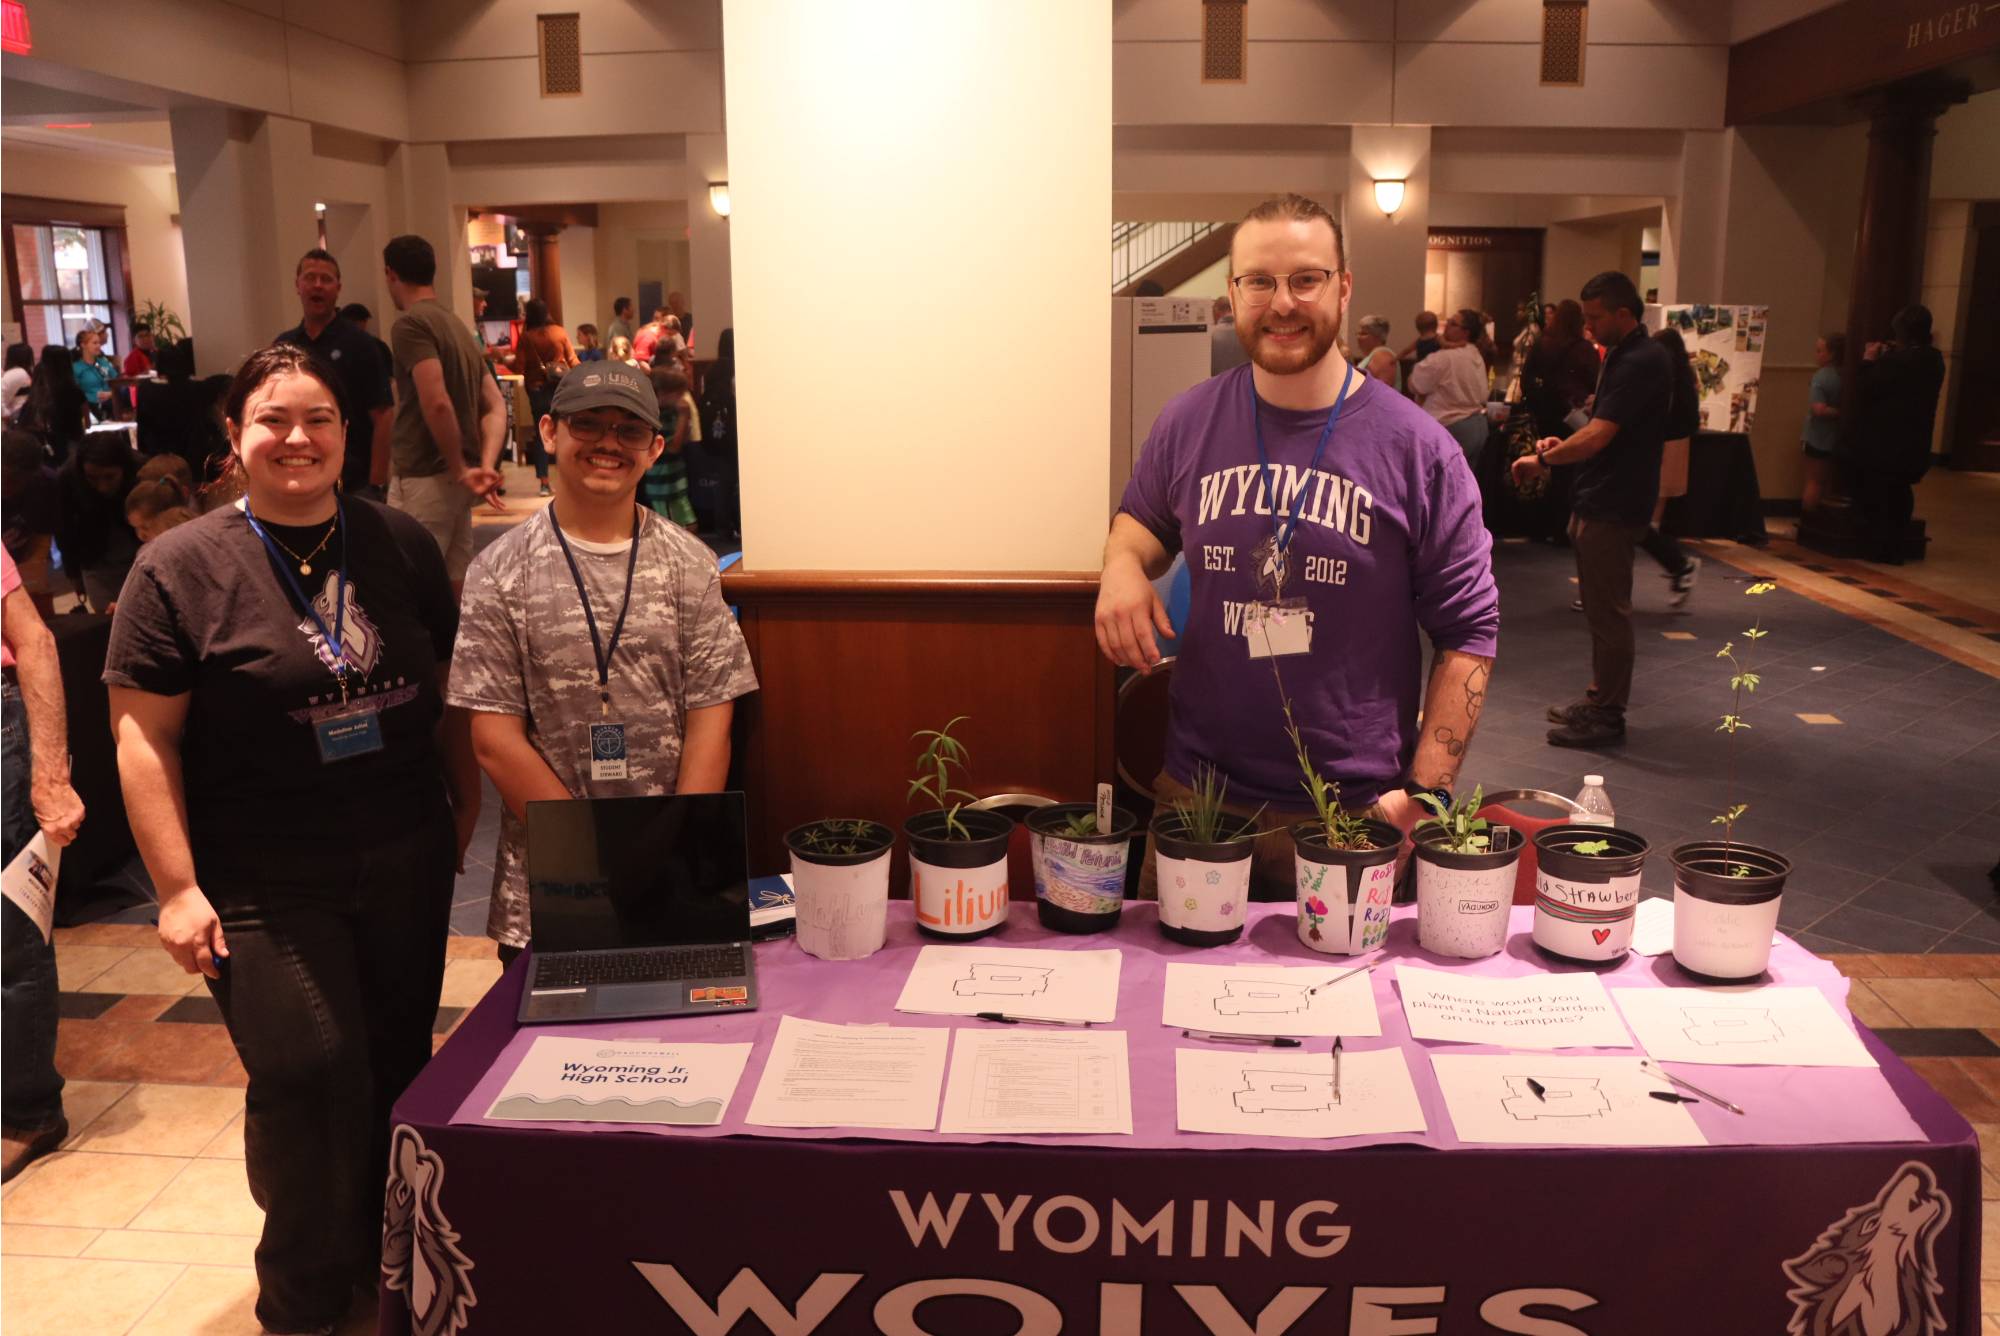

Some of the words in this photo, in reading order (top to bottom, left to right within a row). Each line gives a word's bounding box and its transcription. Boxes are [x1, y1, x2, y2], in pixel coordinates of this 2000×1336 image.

[1199, 463, 1373, 546] WYOMING
[1203, 545, 1236, 572] EST.
[1305, 555, 1347, 585] 2012
[1427, 991, 1485, 1006] Where
[1494, 994, 1543, 1007] would
[1548, 995, 1580, 1004] you
[1412, 1001, 1454, 1011] plant
[1477, 1006, 1534, 1017] Native
[1539, 1003, 1606, 1013] Garden
[1440, 1014, 1463, 1022] on
[1469, 1018, 1497, 1026] our
[1503, 1014, 1584, 1027] campus?
[563, 1063, 661, 1075] Wyoming
[667, 1065, 689, 1075] Jr.
[560, 1073, 608, 1084] High
[615, 1074, 689, 1084] School
[888, 1189, 1352, 1258] WYOMING
